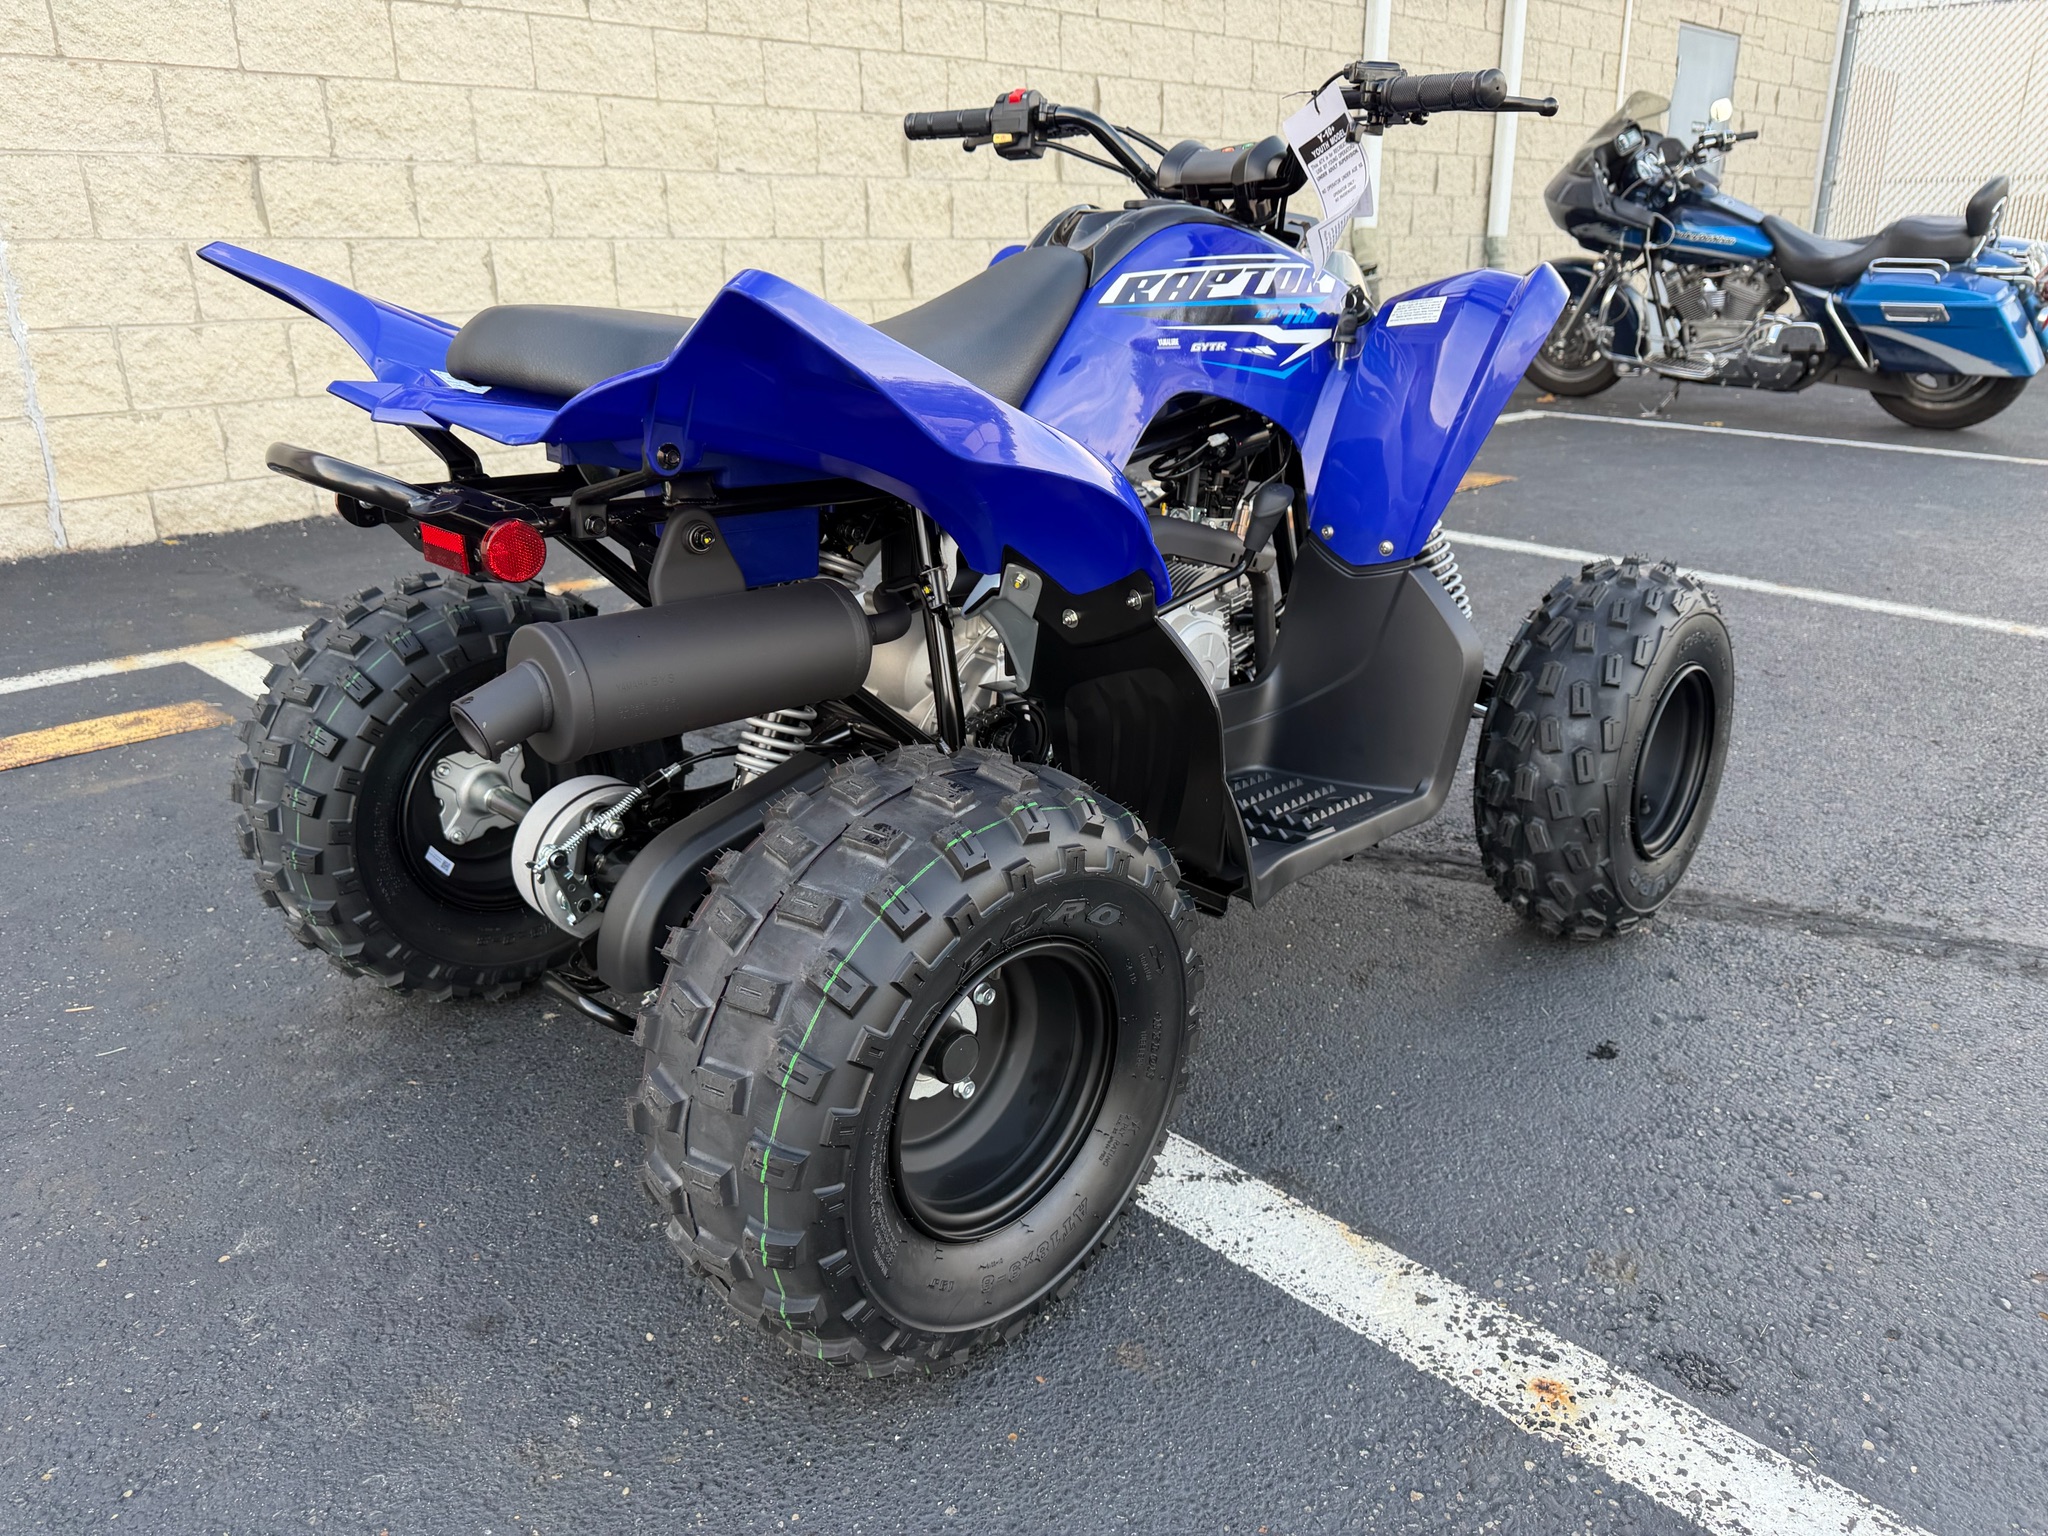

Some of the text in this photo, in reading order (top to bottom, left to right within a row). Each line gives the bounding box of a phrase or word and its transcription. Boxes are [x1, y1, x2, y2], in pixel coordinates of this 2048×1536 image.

[1311, 128, 1346, 158] YOUTH MODEL
[1317, 126, 1335, 143] Y-10+
[1190, 341, 1227, 353] GYTR
